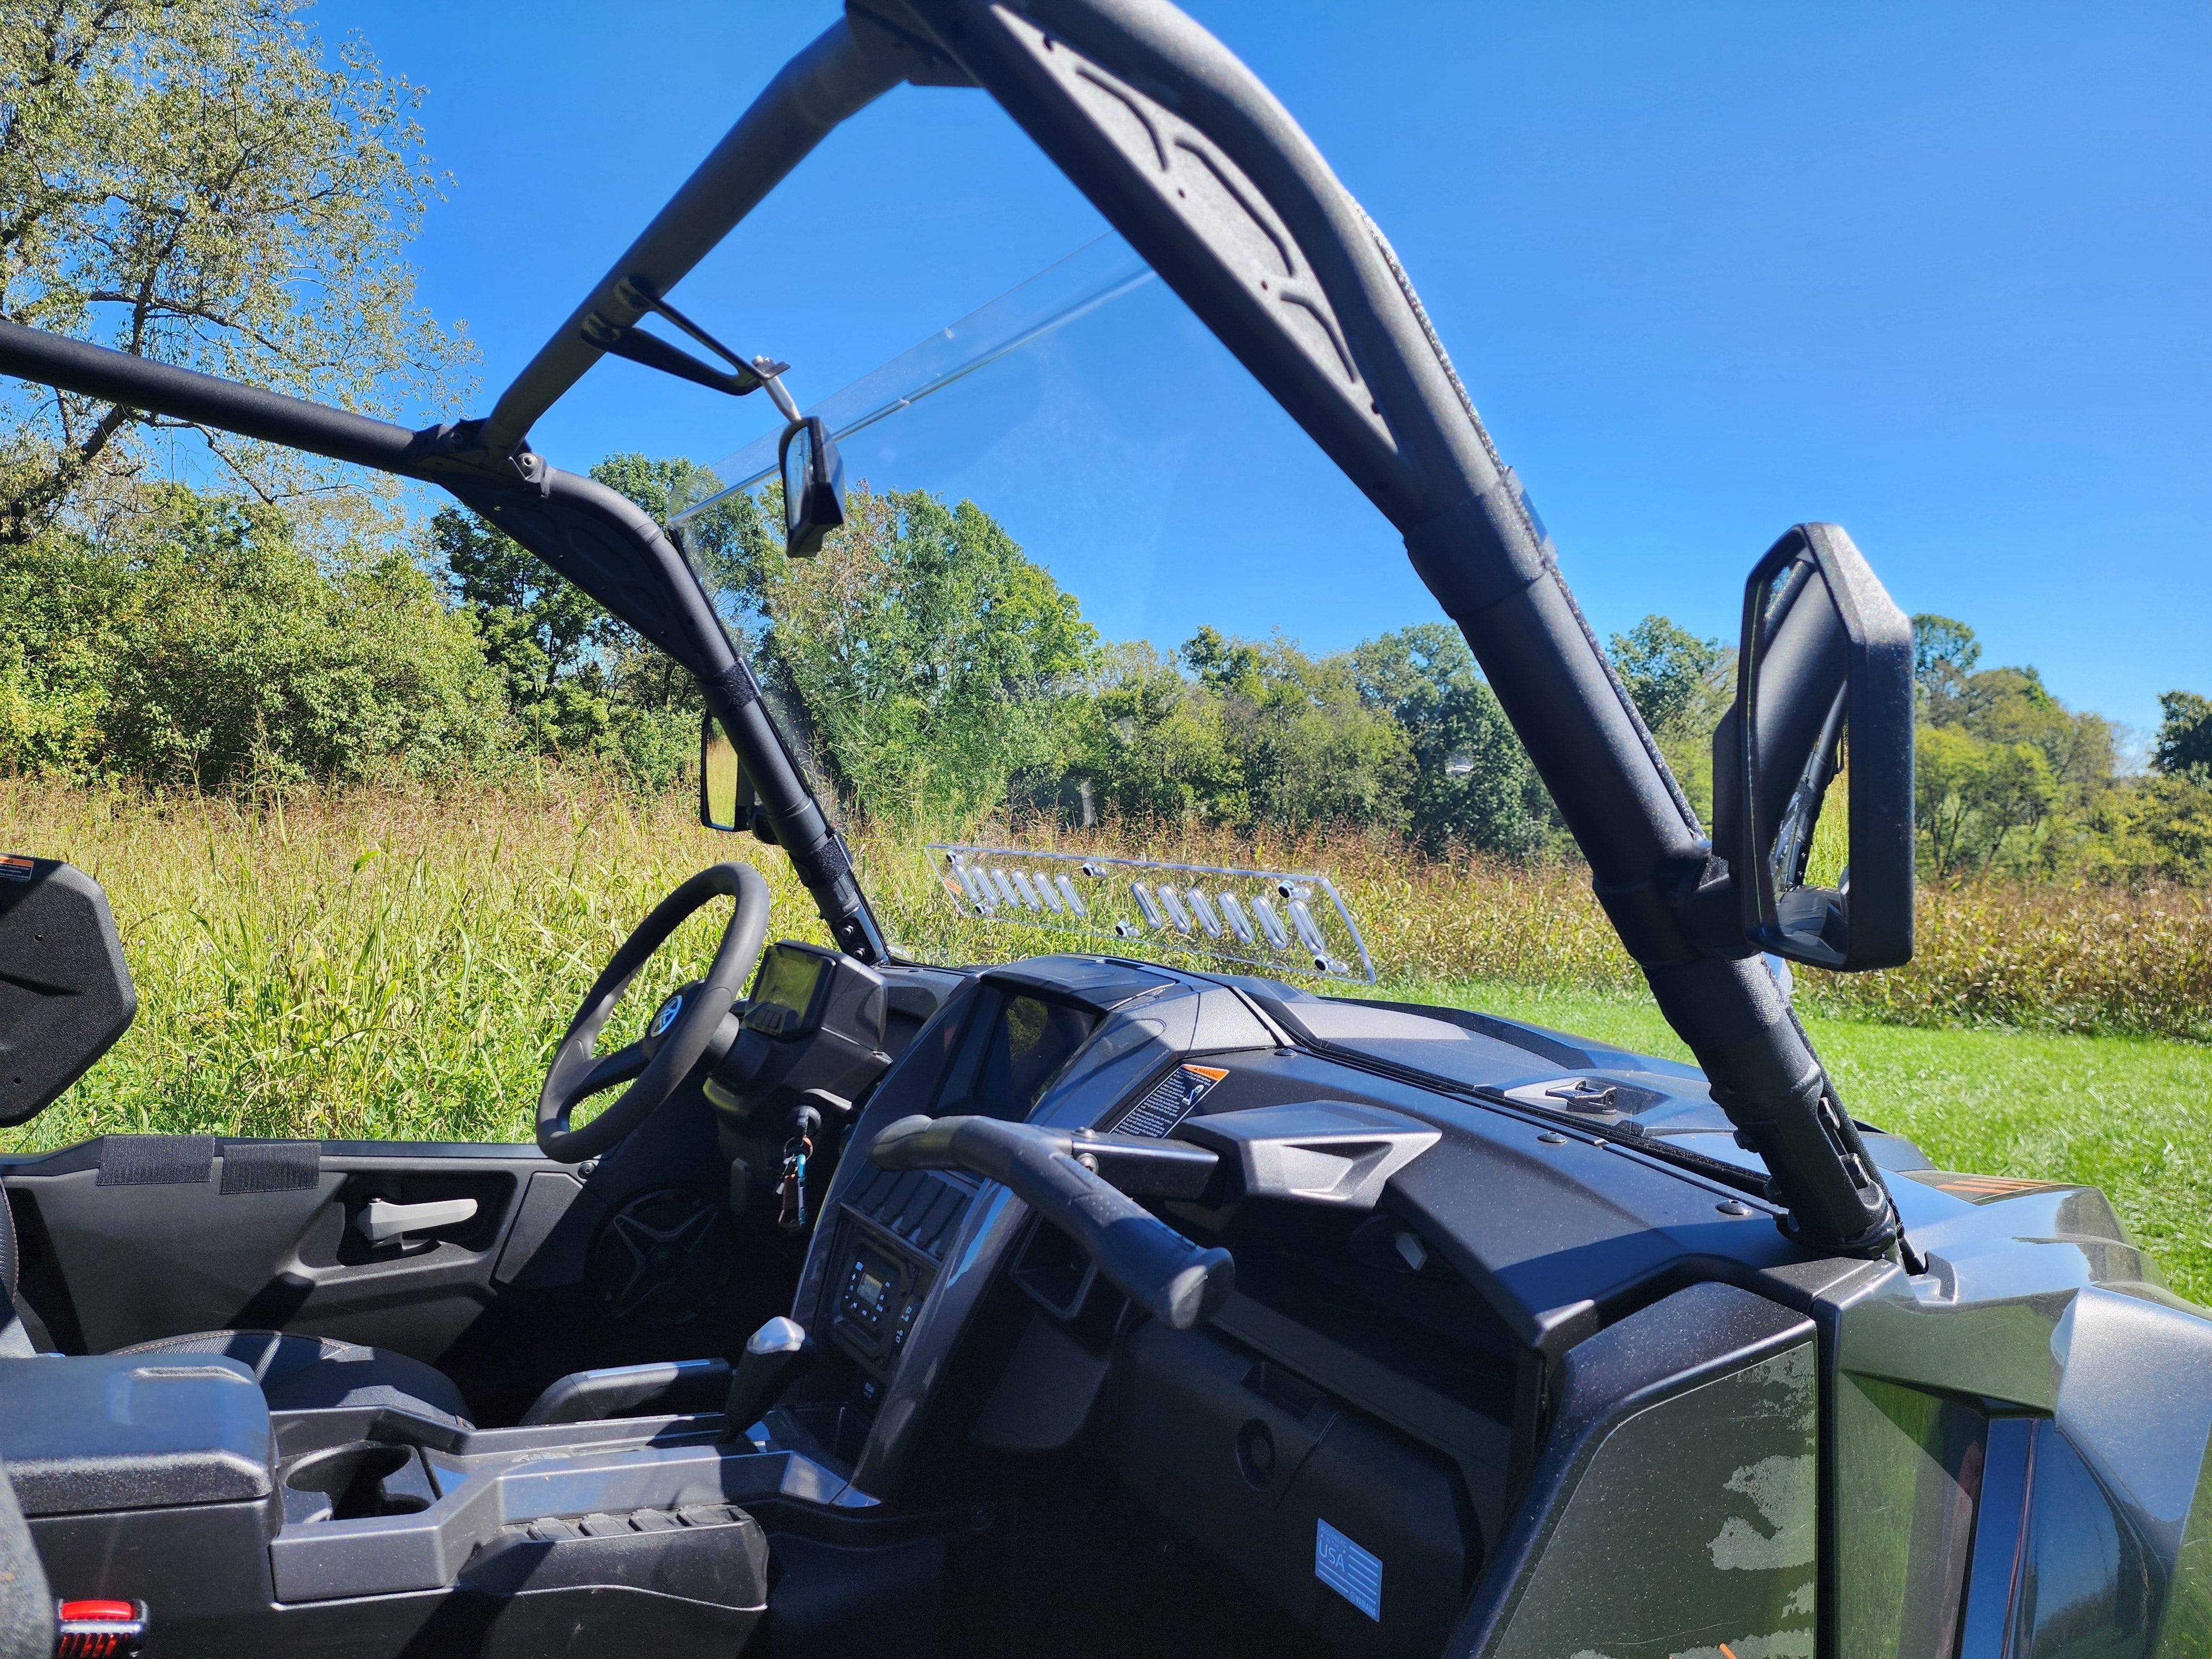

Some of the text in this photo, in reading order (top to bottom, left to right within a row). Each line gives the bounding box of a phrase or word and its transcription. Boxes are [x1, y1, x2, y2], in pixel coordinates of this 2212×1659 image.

[1198, 1068, 1219, 1078] WARNING
[1319, 1539, 1345, 1572] USA
[1356, 1596, 1376, 1617] YAMAHA
